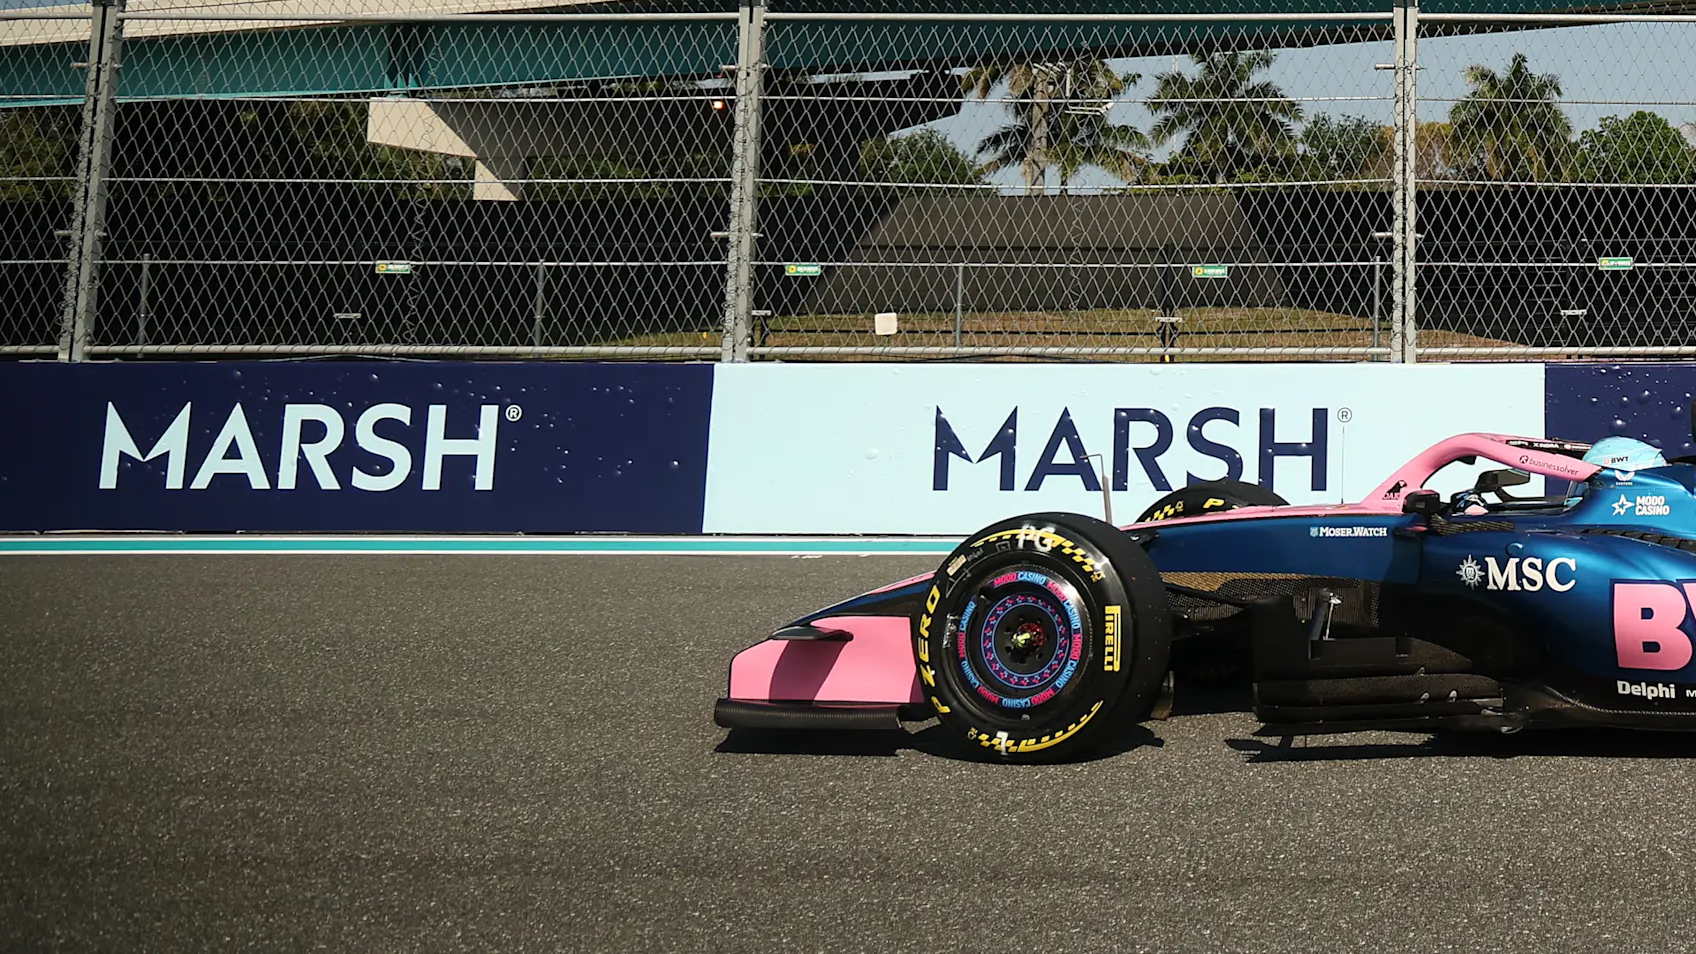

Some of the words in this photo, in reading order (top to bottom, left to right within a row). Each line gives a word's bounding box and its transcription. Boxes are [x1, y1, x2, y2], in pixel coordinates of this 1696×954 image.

[1529, 458, 1579, 476] businessolver
[1635, 505, 1670, 516] CASINO
[1636, 496, 1665, 506] MODO
[1017, 571, 1047, 586] CASINO
[1484, 556, 1576, 592] MSC
[959, 600, 977, 631] CASINO
[1064, 599, 1081, 630] CASINO
[918, 584, 941, 687] ZERO
[1104, 605, 1121, 672] PIRELLI
[961, 660, 979, 689] CASINO
[1055, 659, 1077, 689] CASINO
[931, 696, 951, 713] P
[1617, 680, 1676, 700] Delphi
